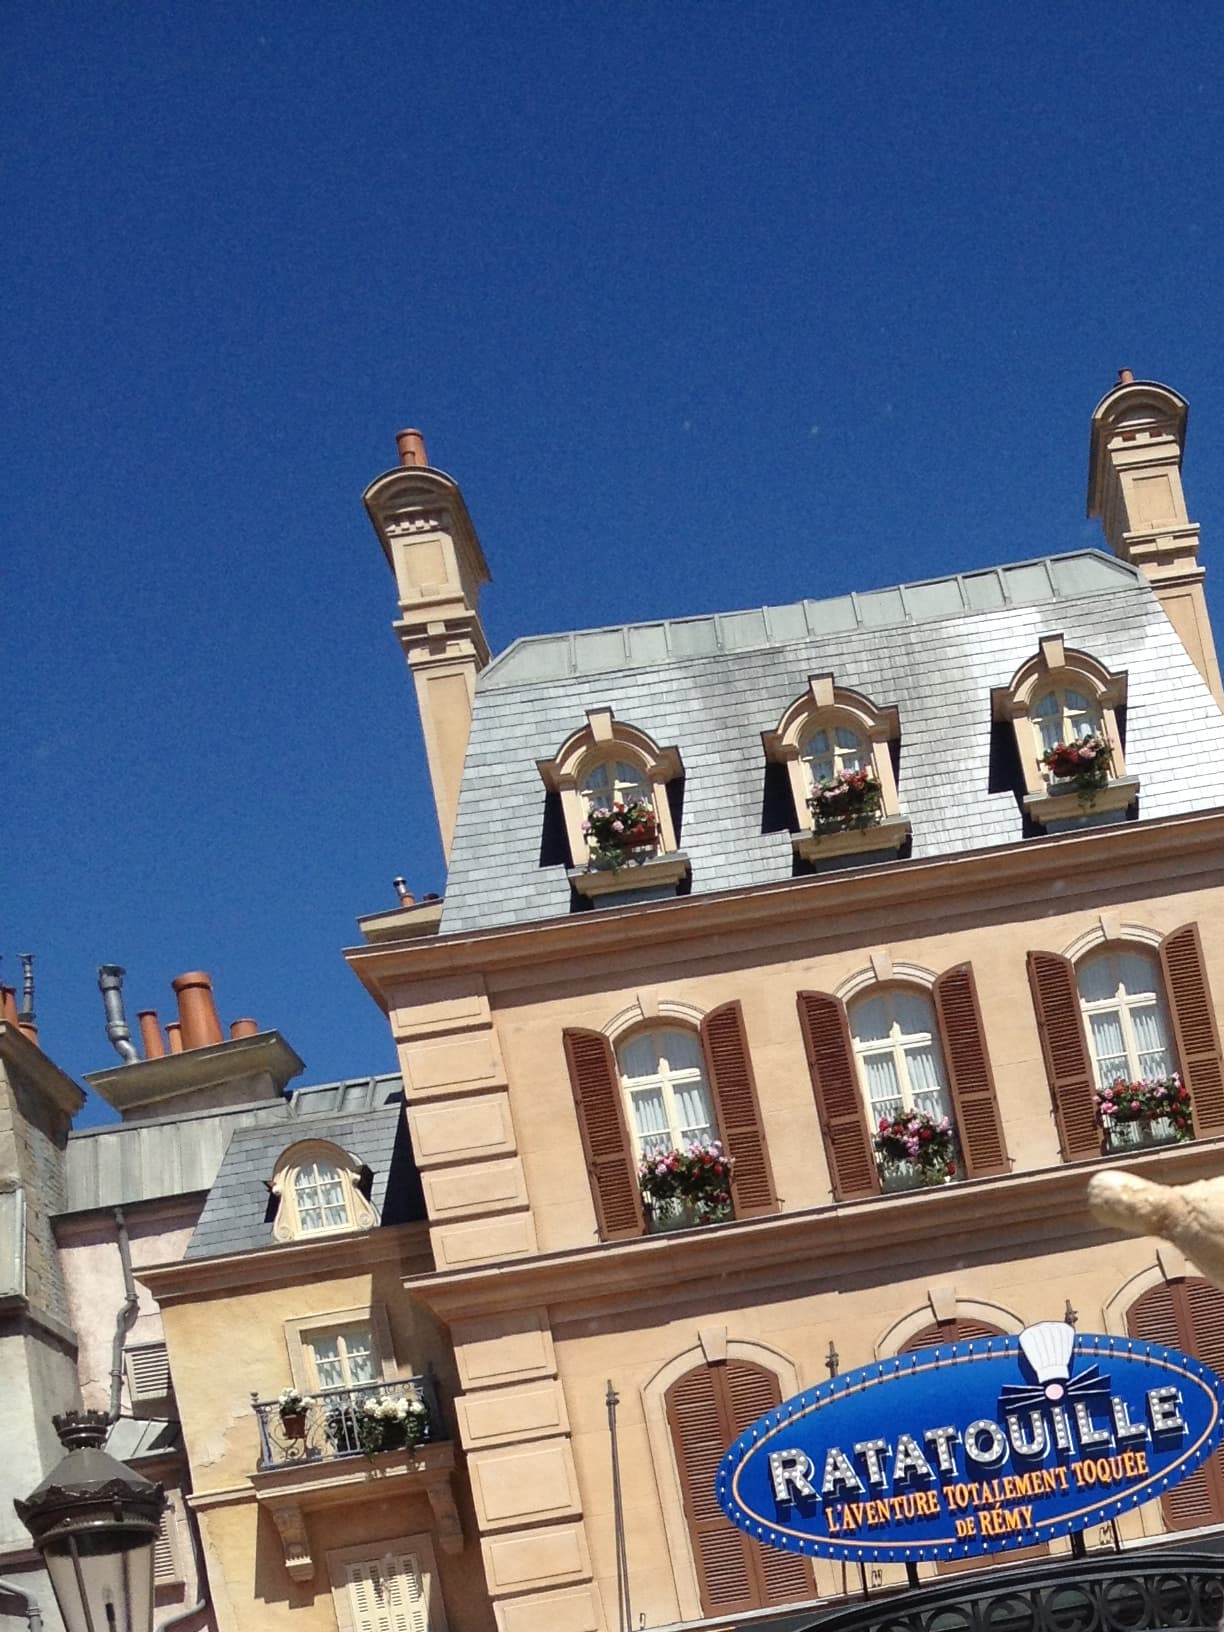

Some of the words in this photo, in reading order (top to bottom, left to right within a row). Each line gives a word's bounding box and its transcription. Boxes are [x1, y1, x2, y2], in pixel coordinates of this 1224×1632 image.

[769, 1384, 1188, 1504] RATATOUILLE
[825, 1489, 941, 1532] L'AVENTURE
[943, 1465, 1069, 1510] TOTALEMENT
[1072, 1446, 1149, 1487] TOQUÉE
[955, 1516, 977, 1537] DE
[979, 1503, 1034, 1535] RÉMY
